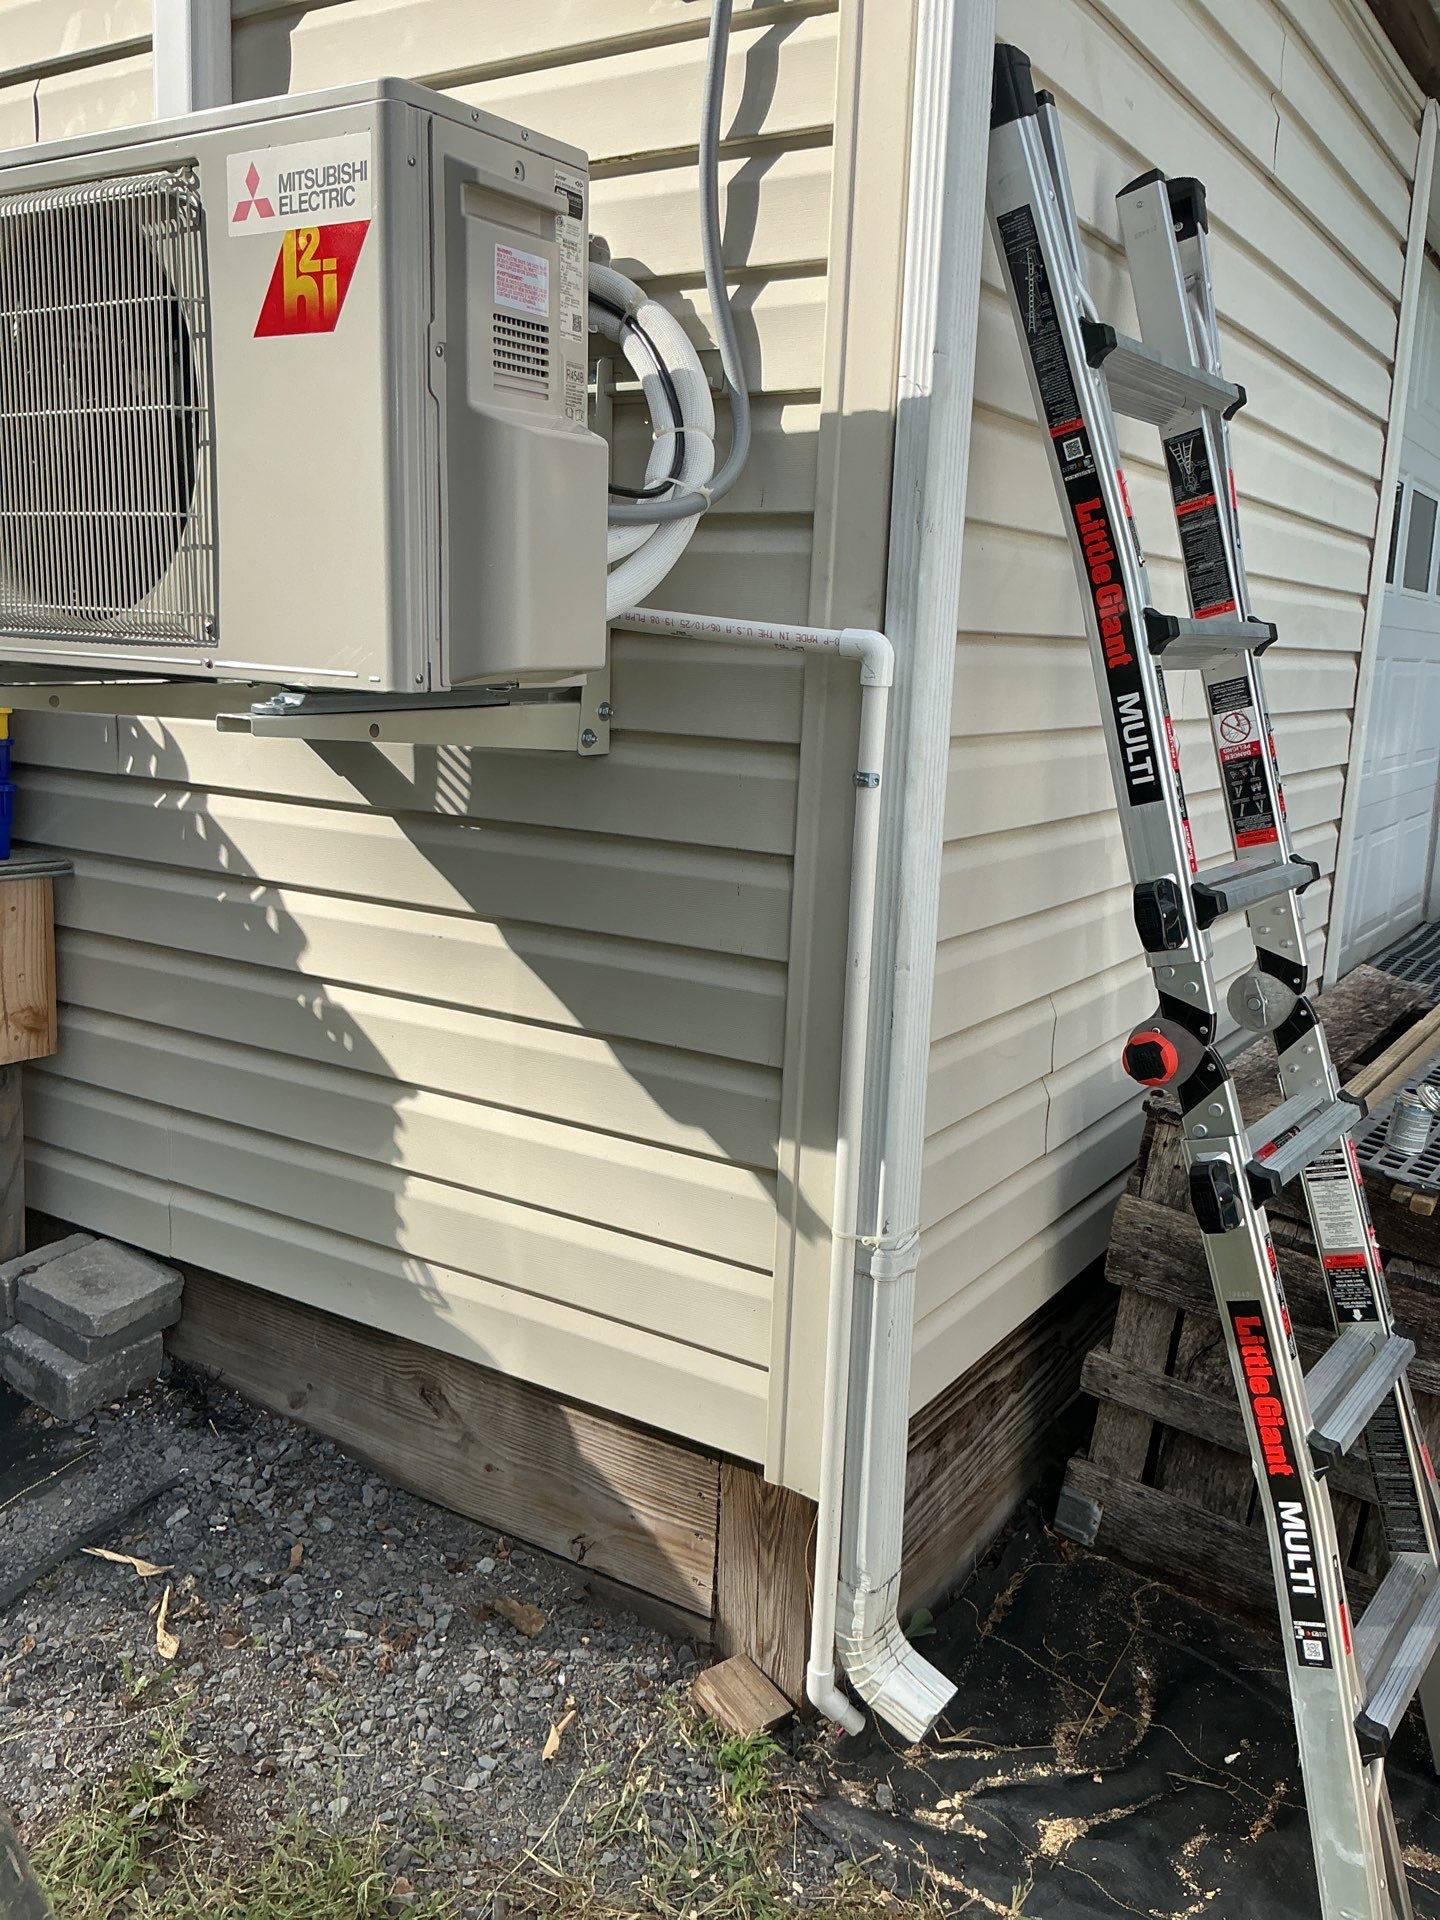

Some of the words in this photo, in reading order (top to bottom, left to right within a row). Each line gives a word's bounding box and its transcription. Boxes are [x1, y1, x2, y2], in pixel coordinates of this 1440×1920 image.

[278, 160, 368, 194] MITSUBISHI
[278, 185, 356, 216] ELECTRIC
[758, 628, 774, 639] THE
[779, 631, 790, 641] IN
[796, 632, 818, 644] MADE
[1116, 691, 1155, 786] MULTI
[1222, 743, 1251, 755] PELIGRO
[1224, 749, 1252, 761] DANGER
[1278, 1501, 1317, 1594] MULTI
